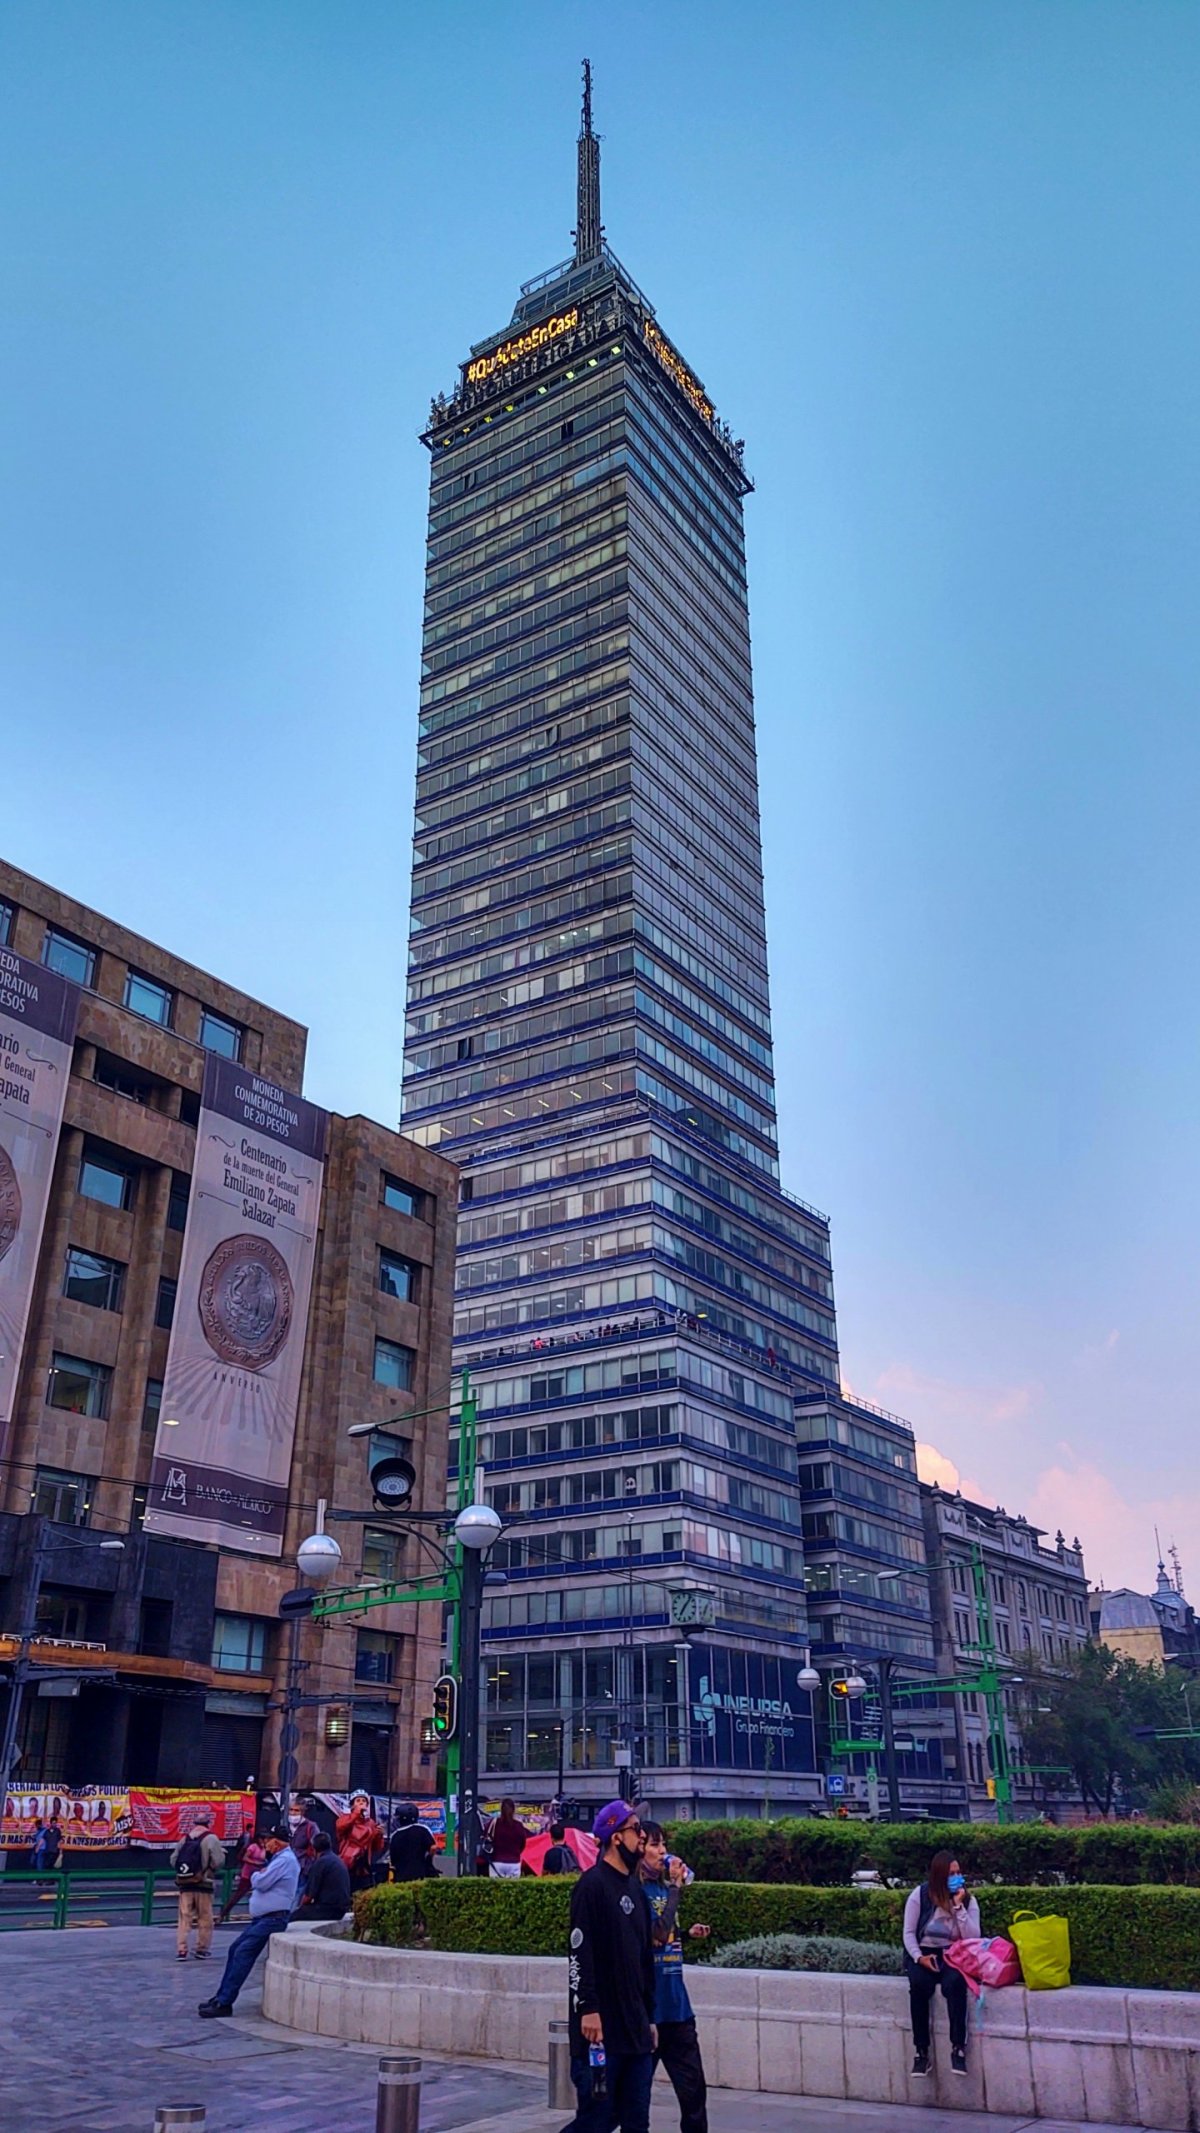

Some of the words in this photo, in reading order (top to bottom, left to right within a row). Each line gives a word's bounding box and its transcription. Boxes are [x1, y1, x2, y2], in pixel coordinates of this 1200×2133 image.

[5, 1055, 36, 1082] General
[252, 1077, 284, 1104] MONEDA
[234, 1085, 299, 1127] CONMEMORATIVA
[243, 1105, 254, 1122] DE
[255, 1111, 265, 1126] 20
[266, 1116, 290, 1138] PESOS
[240, 1138, 287, 1174] Centenario
[223, 1152, 233, 1166] de
[233, 1156, 240, 1170] la
[241, 1162, 264, 1179] muerte
[265, 1169, 276, 1184] del
[276, 1176, 299, 1197] General
[223, 1169, 266, 1202] Emiliano
[267, 1187, 296, 1217] Zapata
[241, 1199, 277, 1229] Salazar
[213, 1371, 261, 1394] ANVERSO
[723, 1694, 794, 1720] INBURSA
[735, 1719, 759, 1735] Grupo
[760, 1721, 795, 1738] Financiero
